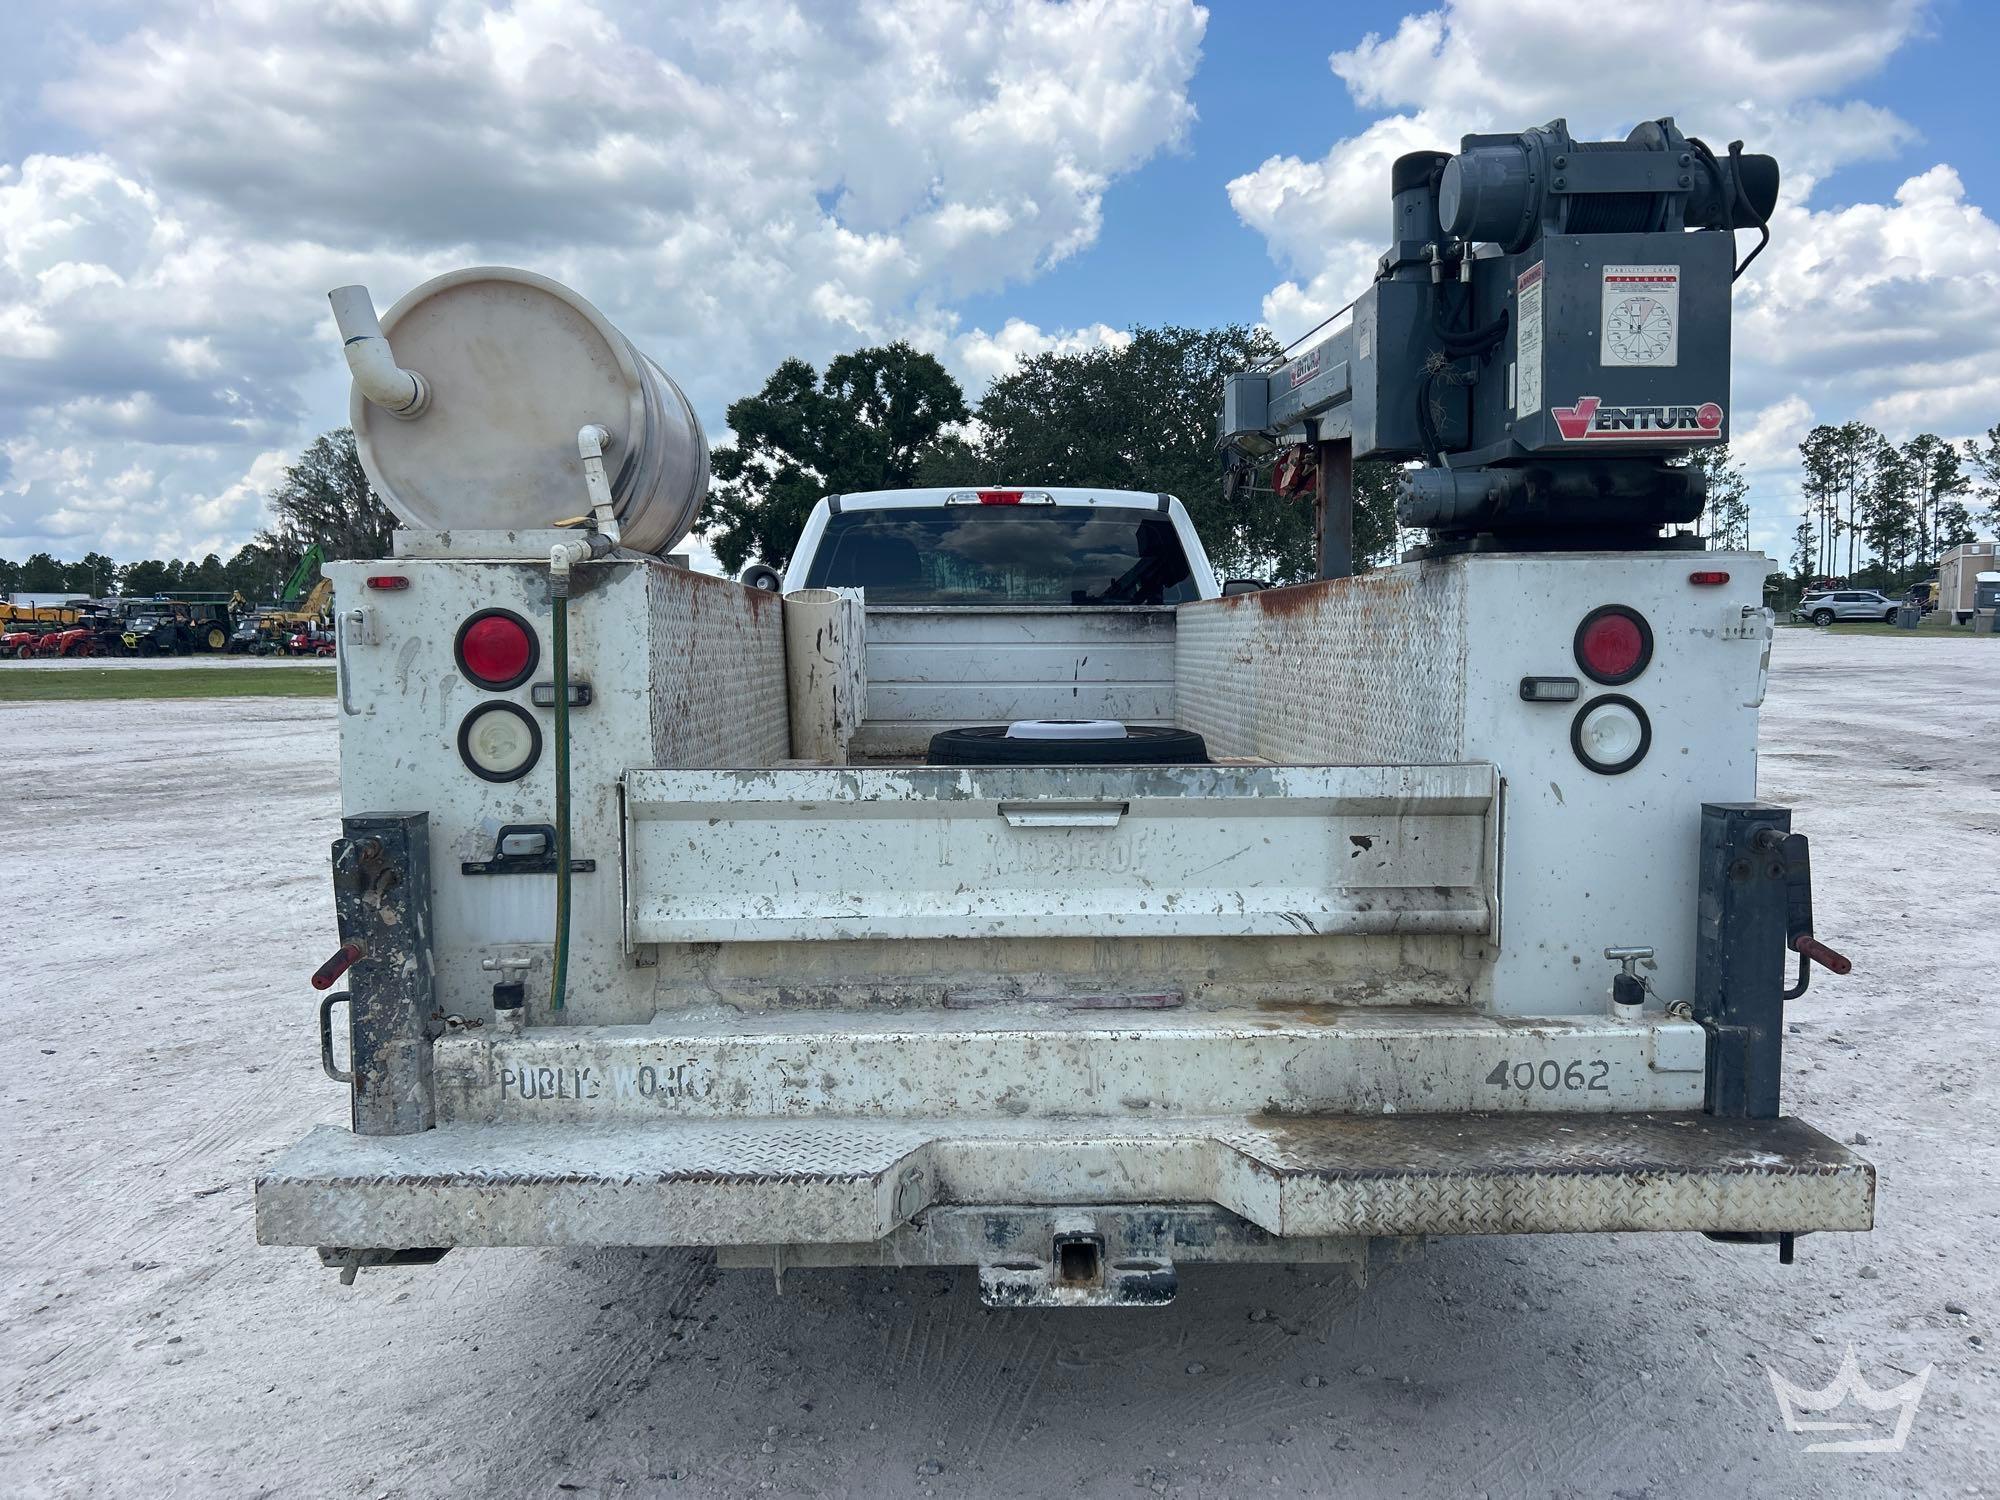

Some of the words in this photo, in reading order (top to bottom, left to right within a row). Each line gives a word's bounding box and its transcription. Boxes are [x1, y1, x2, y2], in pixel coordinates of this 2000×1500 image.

[1552, 397, 1723, 439] VENTURO
[501, 1067, 600, 1100] PUBLIC
[1485, 1060, 1609, 1090] 40062
